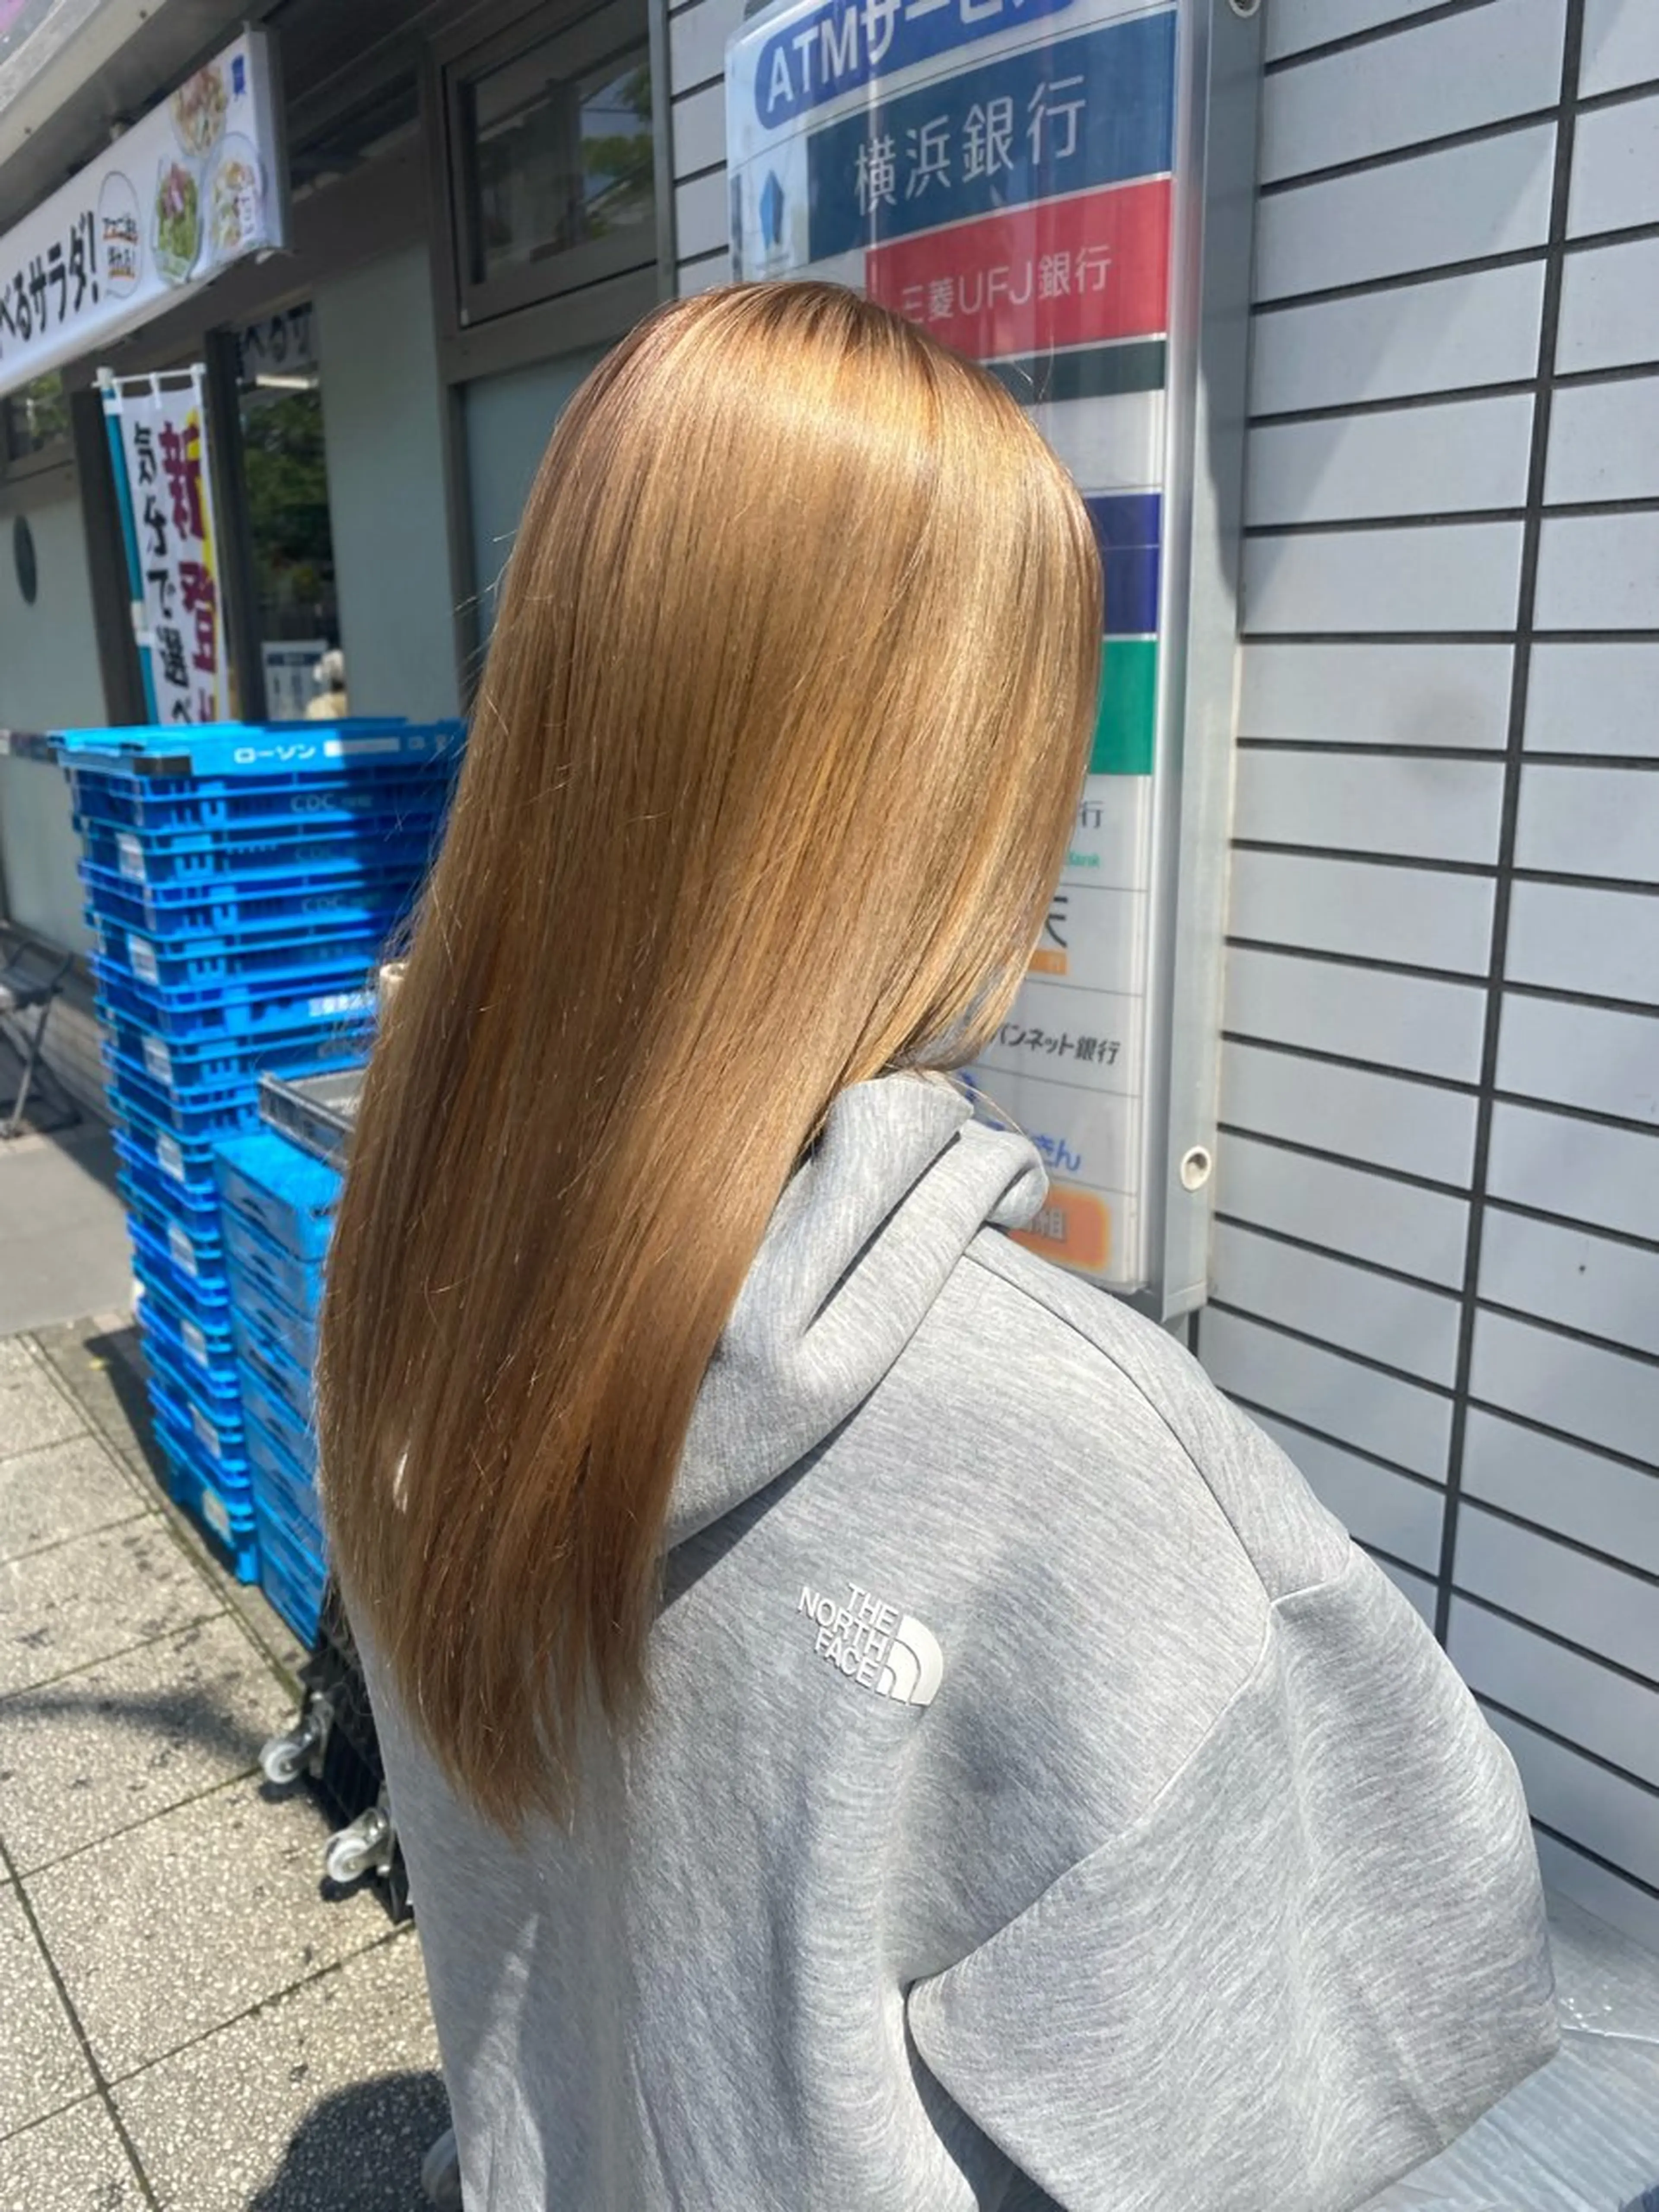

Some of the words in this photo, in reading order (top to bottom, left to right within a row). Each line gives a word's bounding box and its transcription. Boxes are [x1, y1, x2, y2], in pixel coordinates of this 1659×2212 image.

[767, 0, 1025, 113] ATMサー
[855, 74, 1087, 214] 横浜銀行
[902, 245, 1112, 323] 三菱UFJ銀行
[235, 744, 316, 763] ローソン
[798, 1586, 889, 1662] NORTH
[848, 1582, 899, 1634] THE
[815, 1628, 880, 1689] FACE
